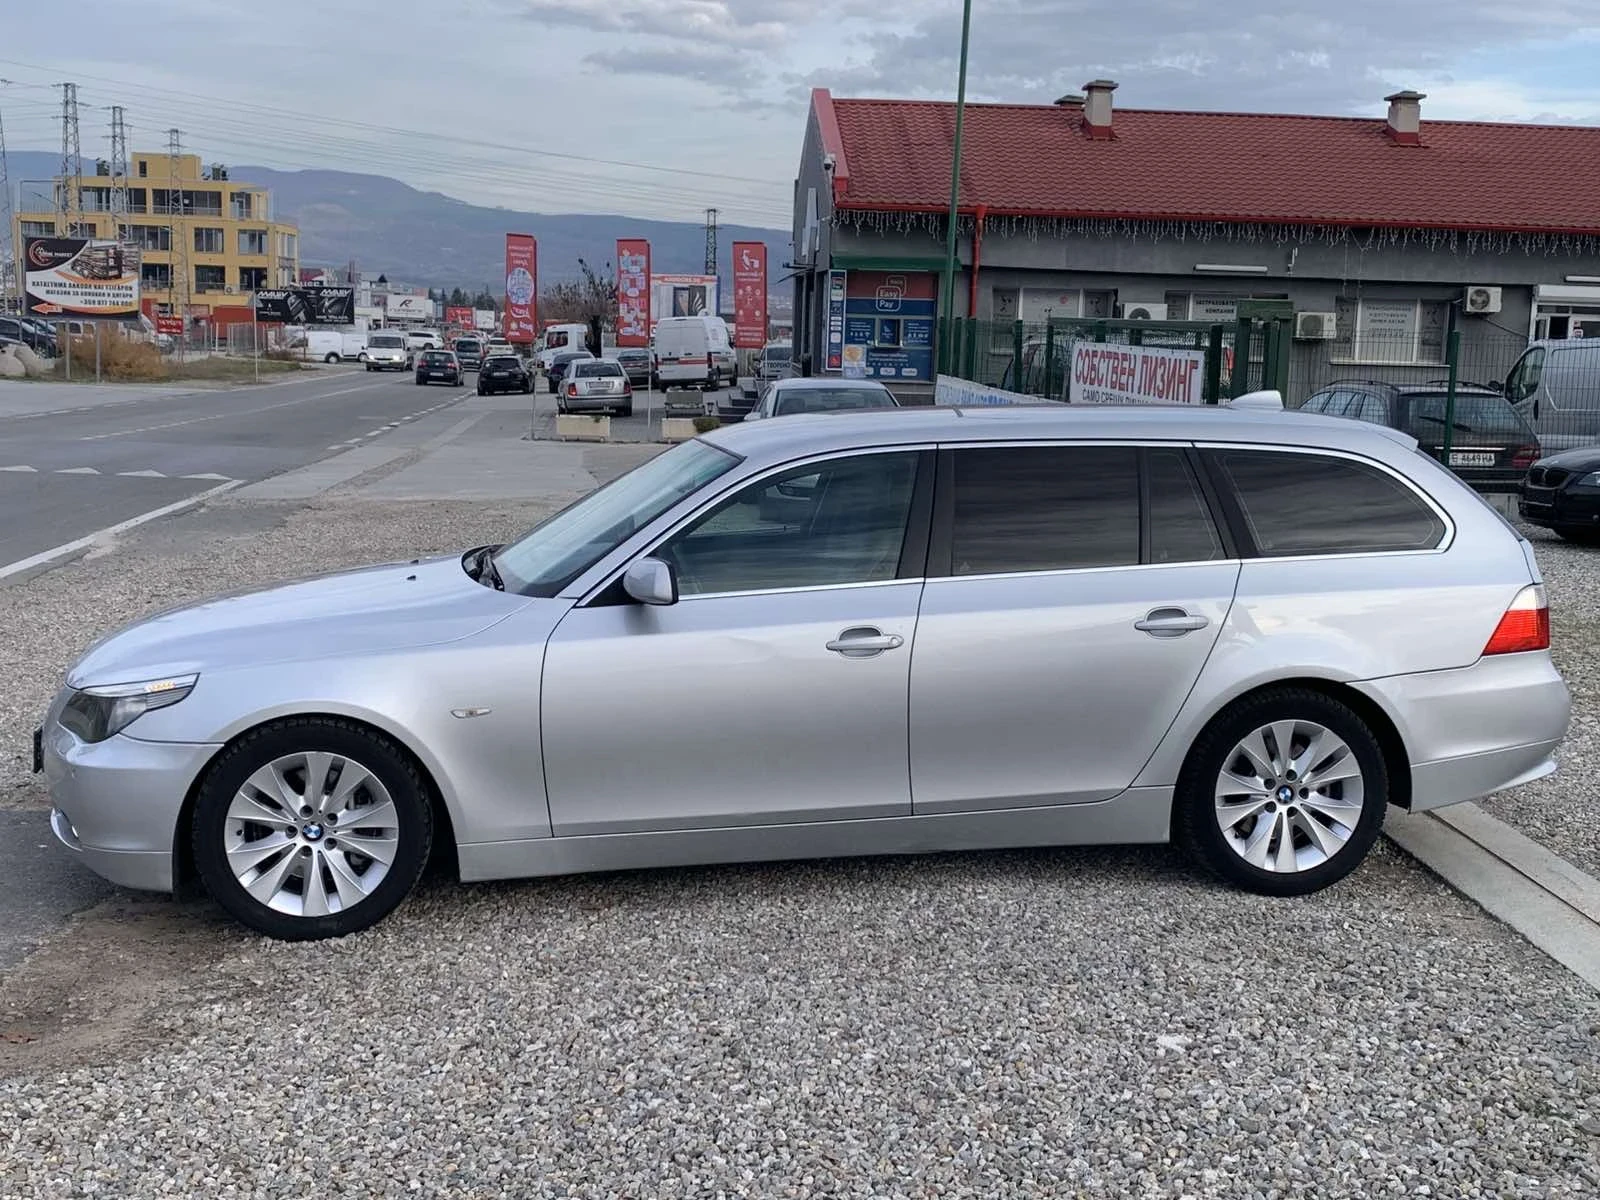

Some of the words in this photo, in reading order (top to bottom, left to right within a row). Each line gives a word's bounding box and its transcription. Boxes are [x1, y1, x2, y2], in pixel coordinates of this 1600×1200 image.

[880, 289, 898, 298] Easy
[880, 300, 894, 309] Pay
[1075, 348, 1137, 393] СОБСТВЕН
[1137, 354, 1199, 403] ЛИЗИНГ
[1082, 389, 1100, 403] САМО
